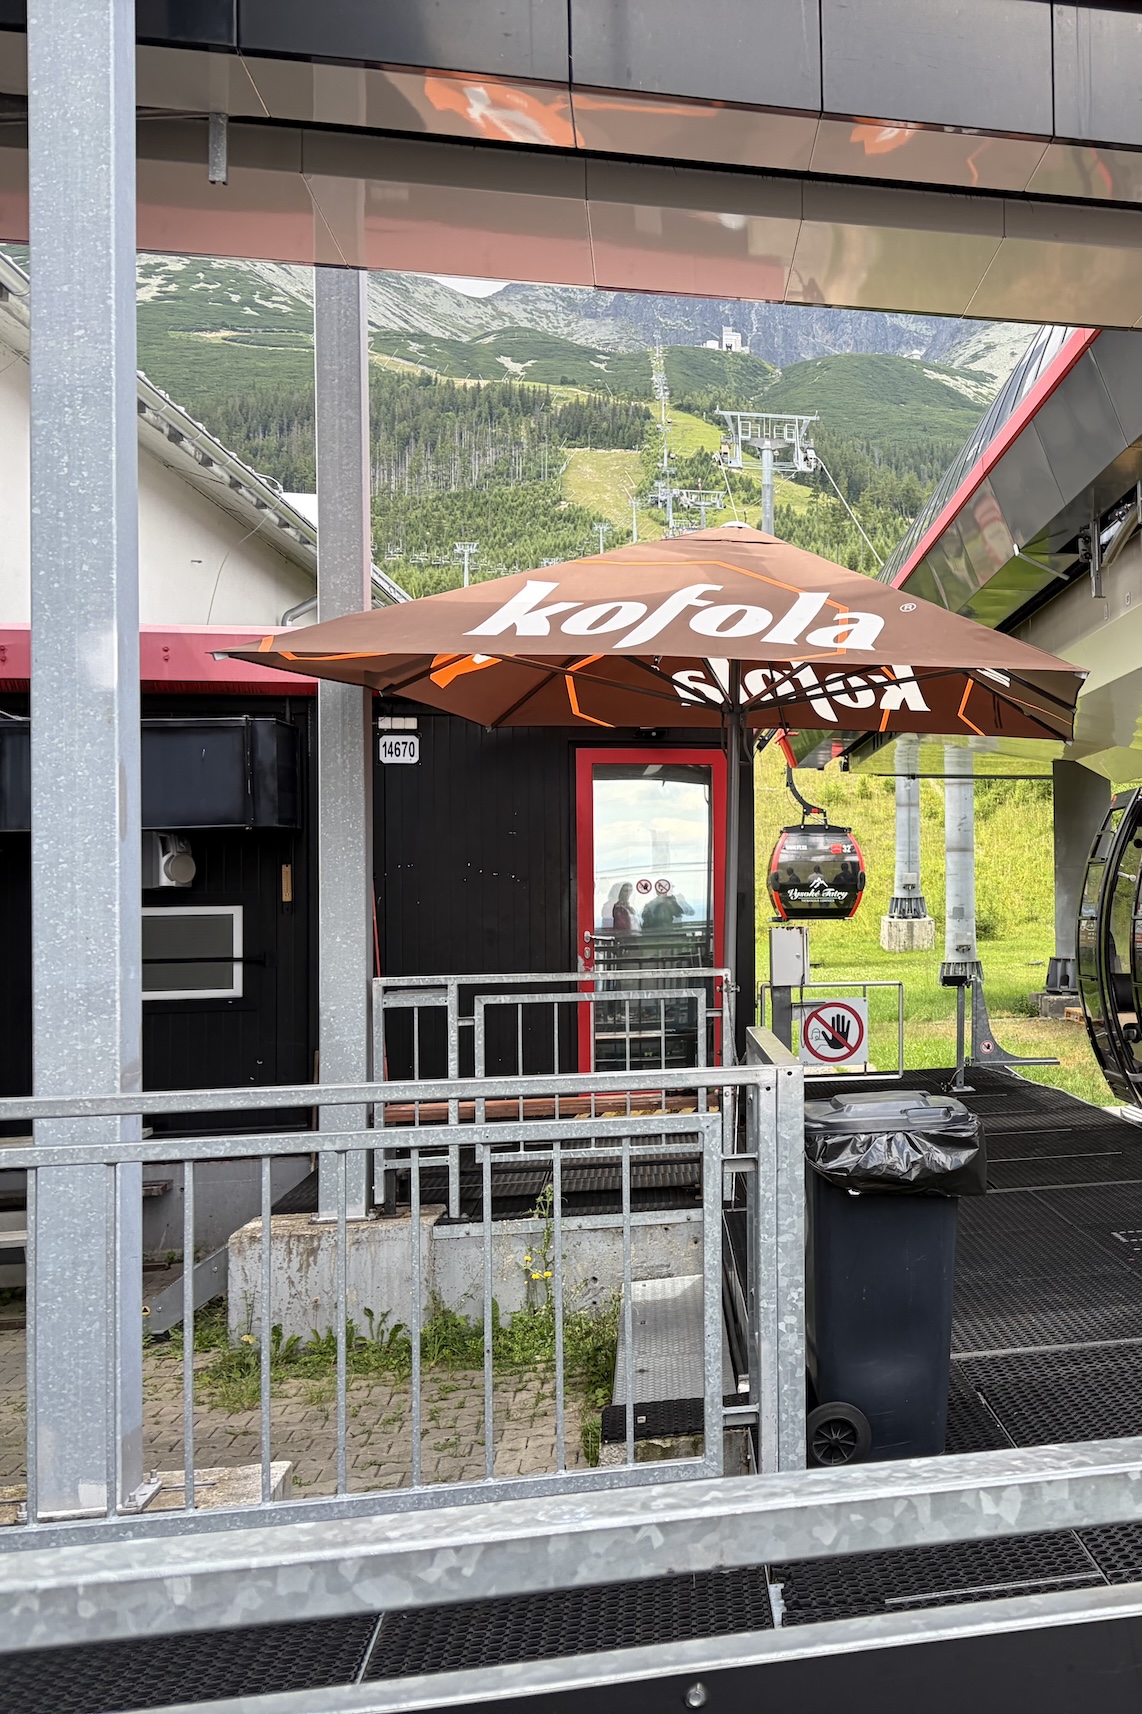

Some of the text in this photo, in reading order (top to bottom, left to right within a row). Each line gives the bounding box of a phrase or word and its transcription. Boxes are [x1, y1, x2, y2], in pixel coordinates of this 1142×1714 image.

[462, 580, 886, 650] kofola
[382, 741, 415, 758] 14670
[842, 845, 851, 853] 32
[787, 888, 848, 900] Vysoké Tatry
